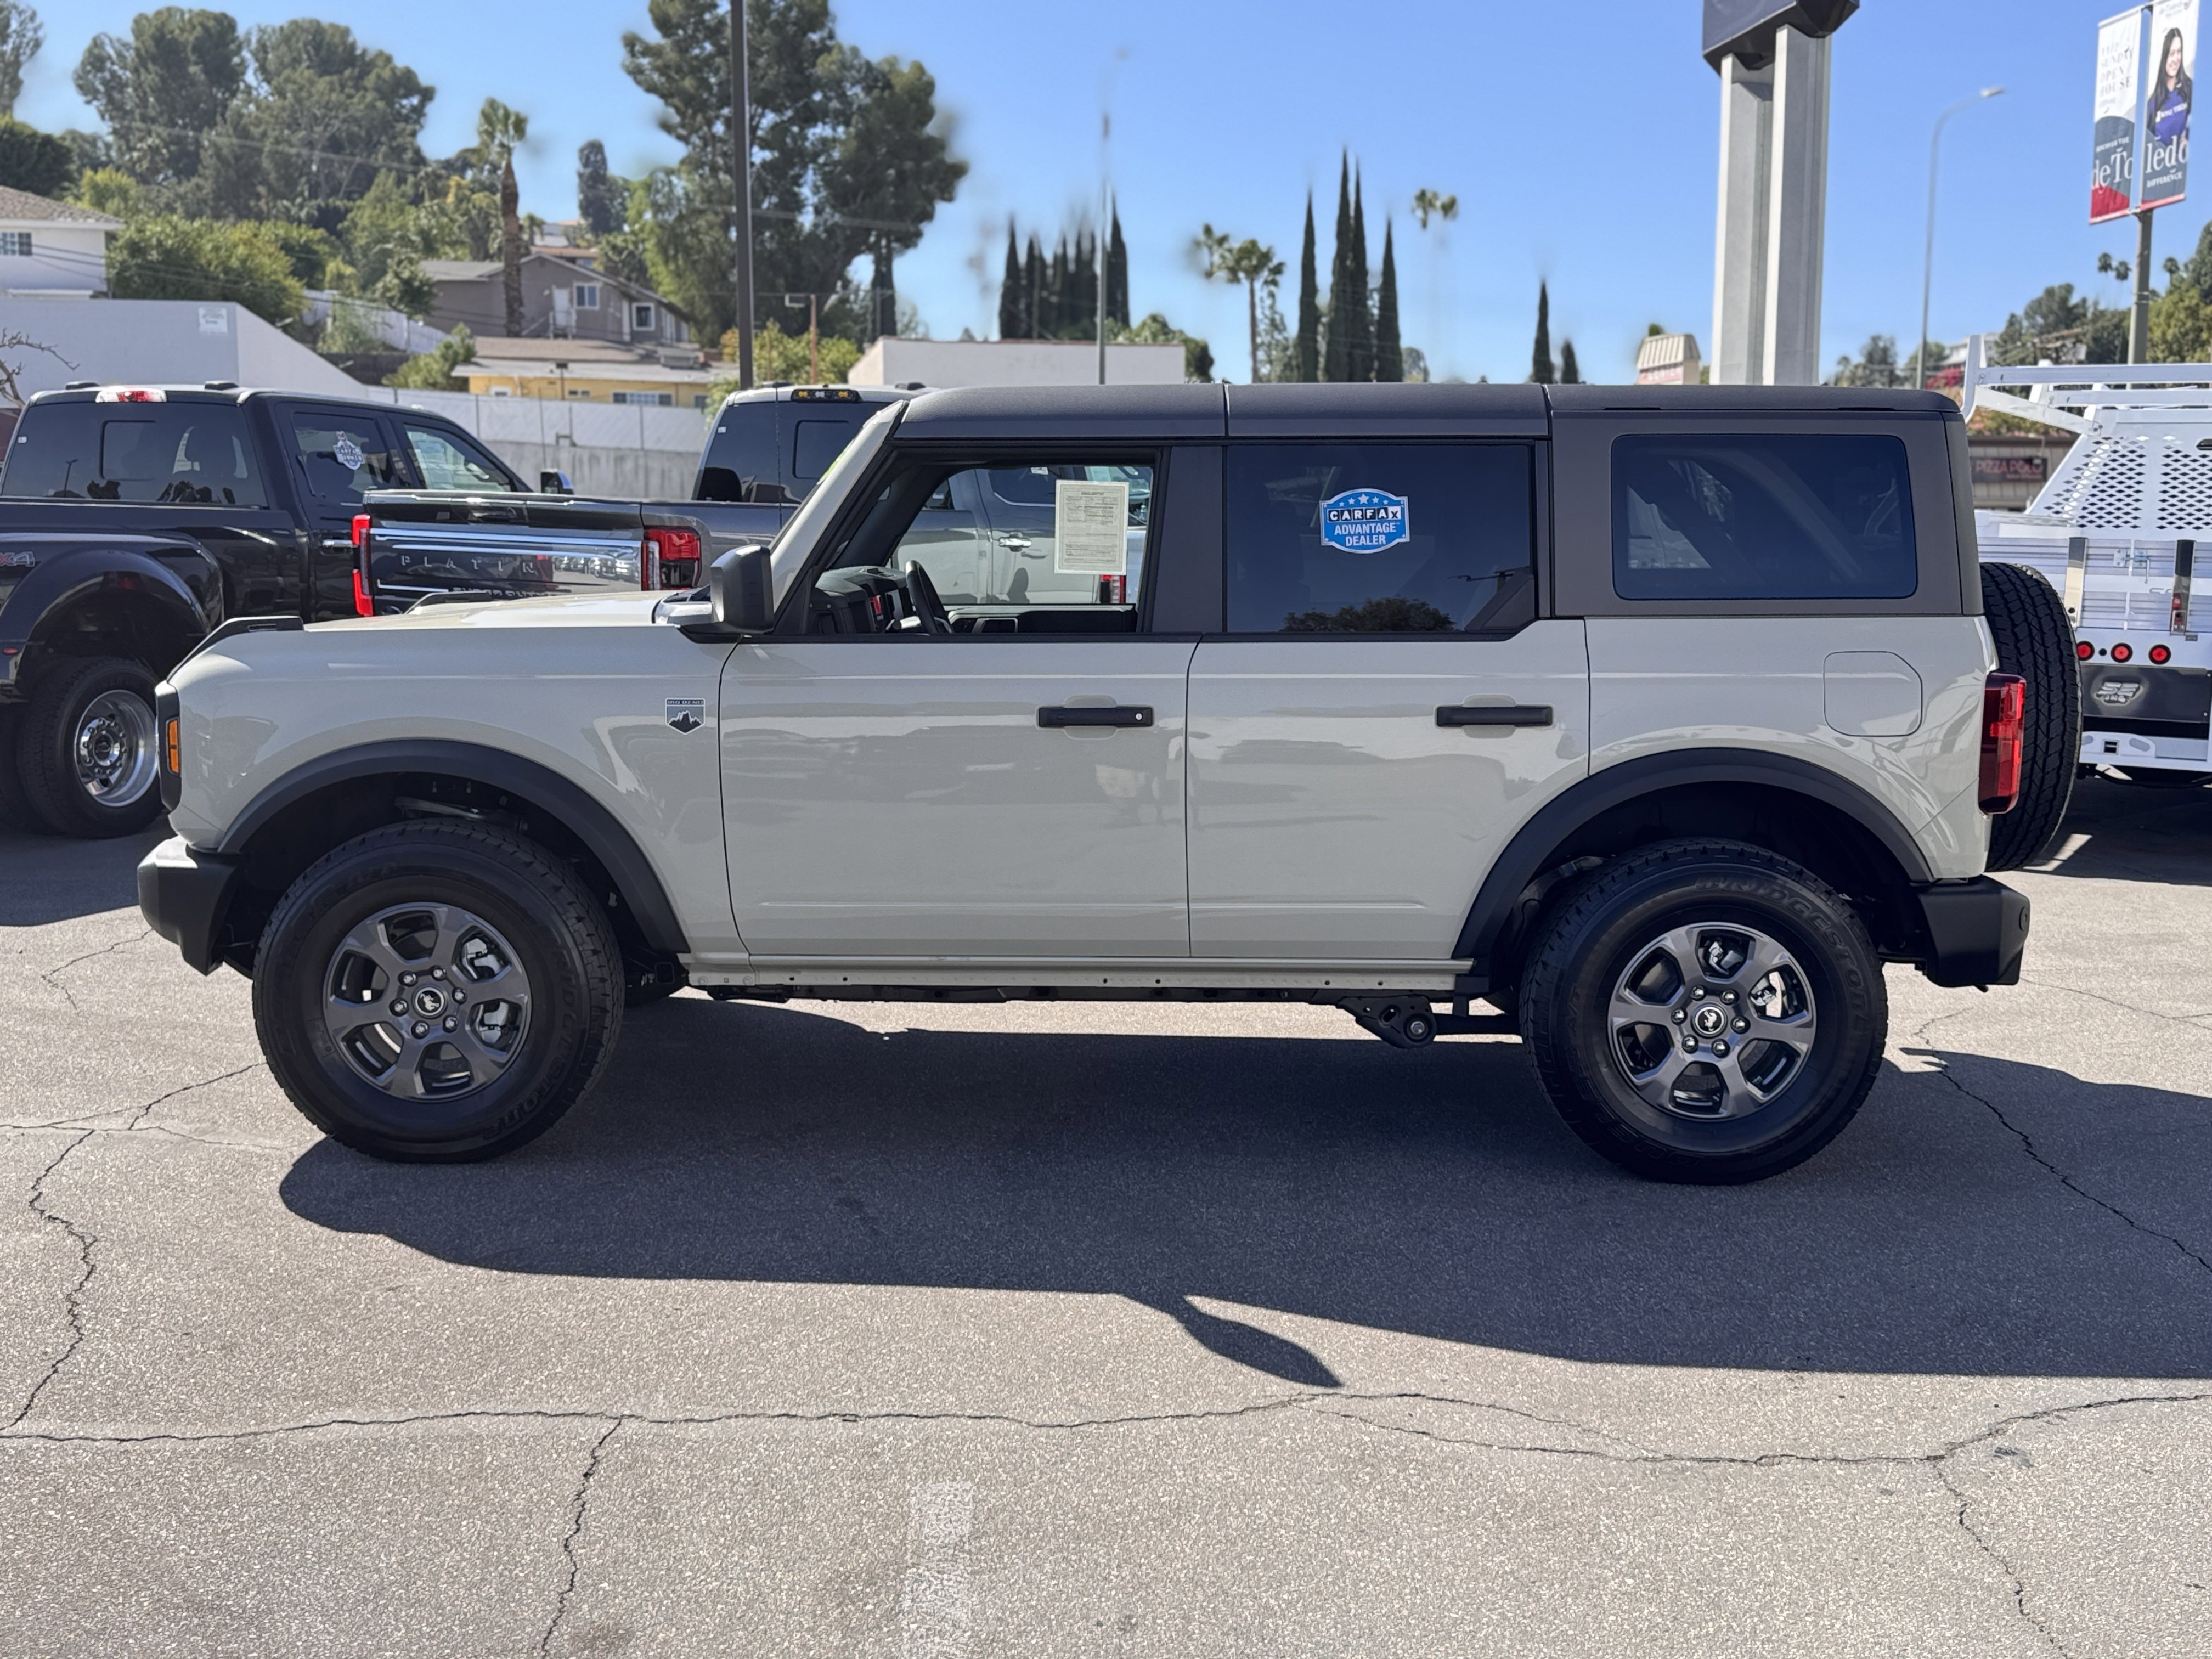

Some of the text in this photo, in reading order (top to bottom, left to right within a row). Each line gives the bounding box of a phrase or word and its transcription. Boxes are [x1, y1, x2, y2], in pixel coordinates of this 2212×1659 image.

[1976, 459, 2008, 474] PIZZA
[1329, 507, 1400, 521] CARFAX
[1334, 522, 1397, 536] ADVANTAGE
[1345, 534, 1387, 547] DEALER
